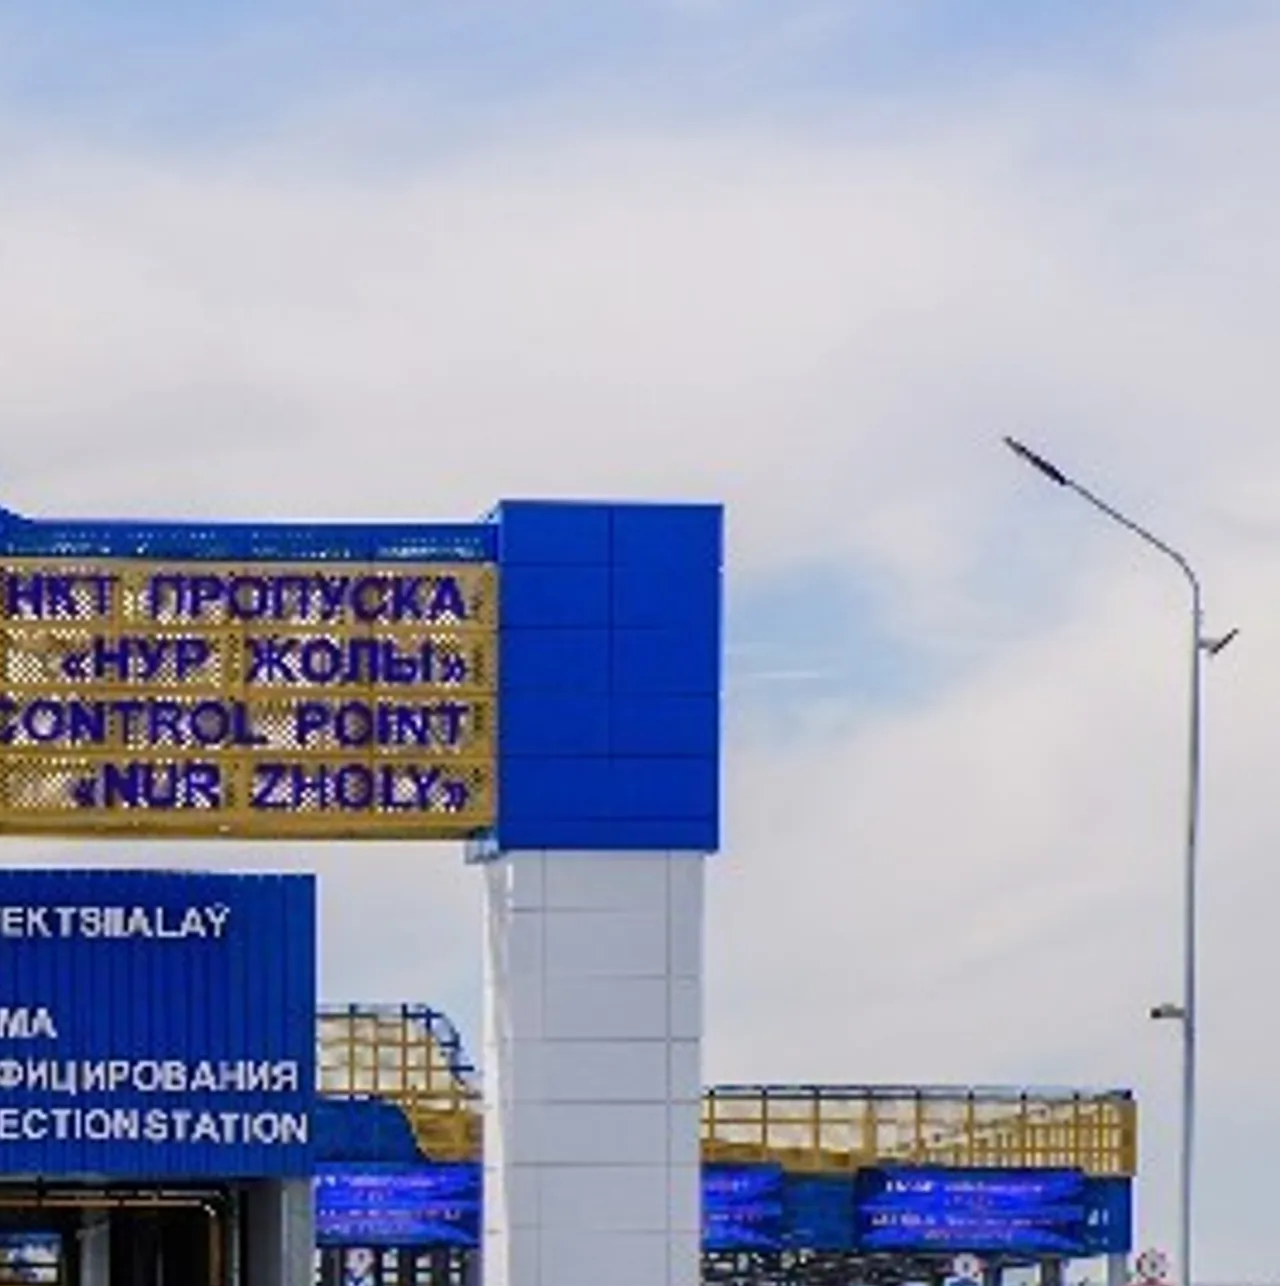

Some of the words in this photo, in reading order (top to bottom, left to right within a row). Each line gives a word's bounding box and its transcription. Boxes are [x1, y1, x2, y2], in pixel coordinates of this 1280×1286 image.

[147, 573, 467, 621] ПРОПУСКА
[295, 702, 470, 748] POINT
[142, 1108, 308, 1144] STATION
